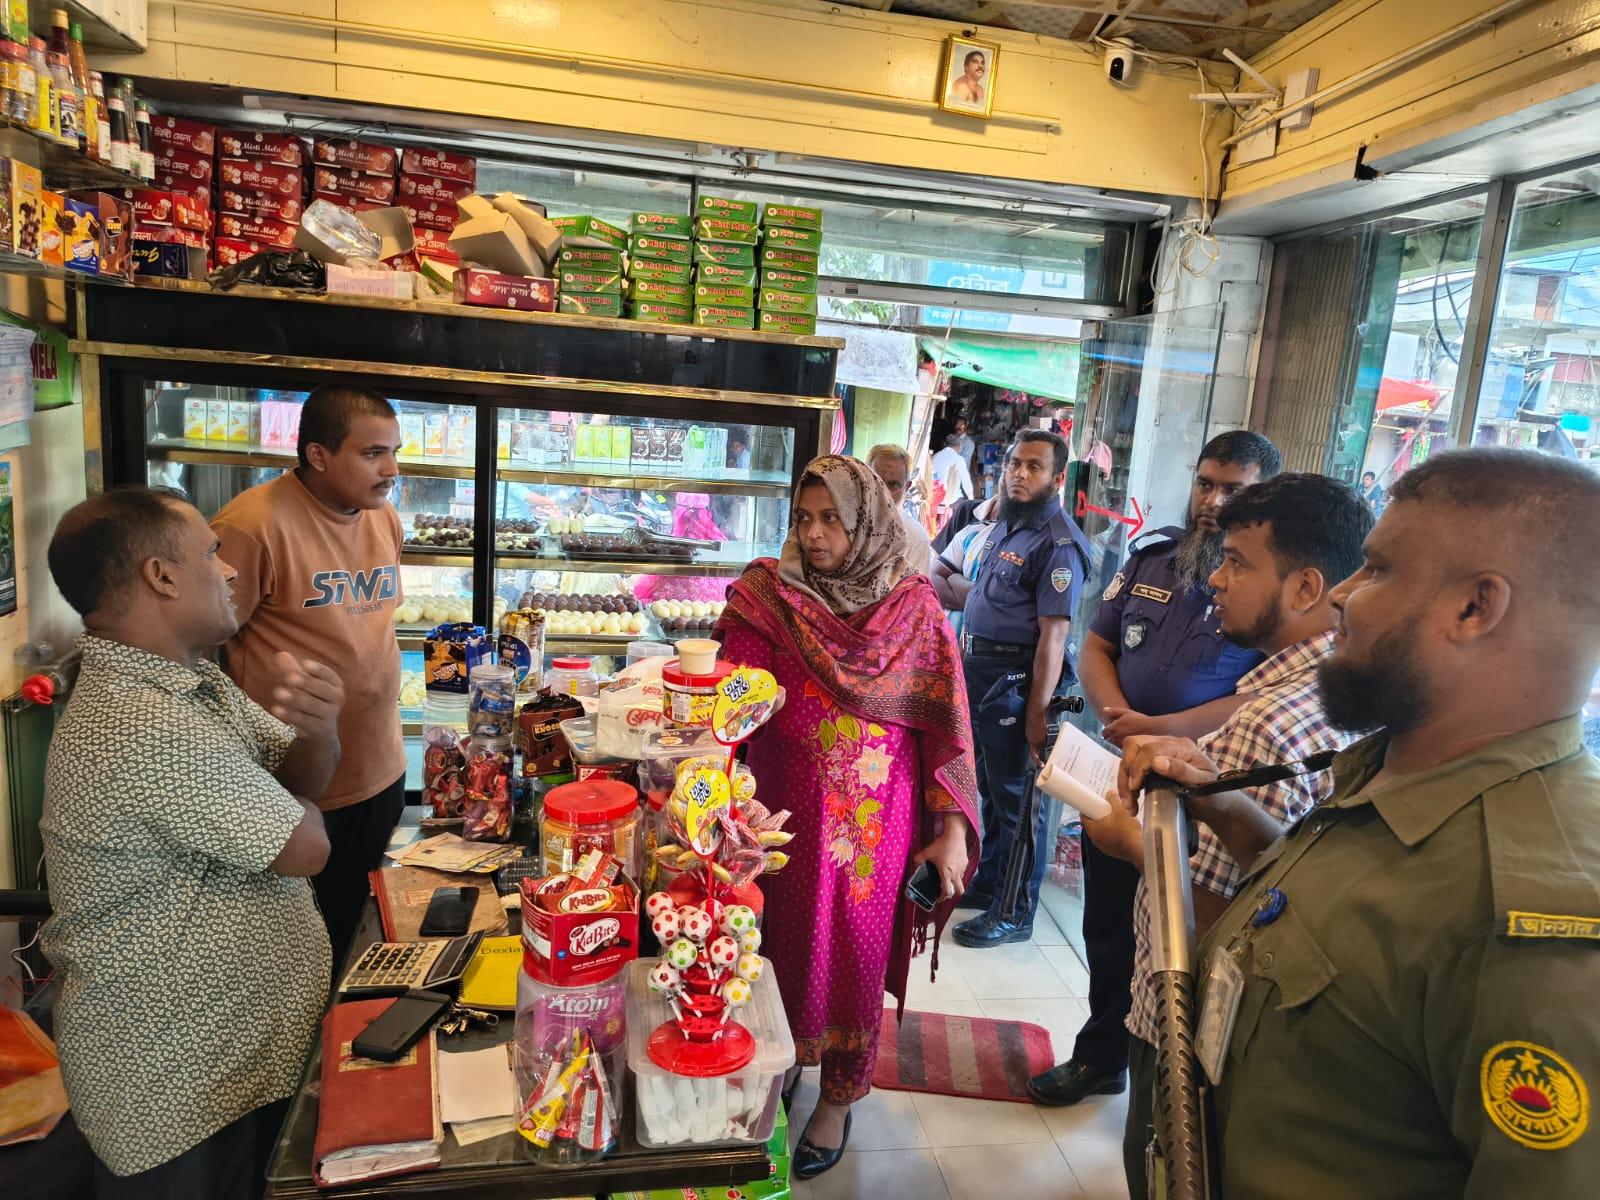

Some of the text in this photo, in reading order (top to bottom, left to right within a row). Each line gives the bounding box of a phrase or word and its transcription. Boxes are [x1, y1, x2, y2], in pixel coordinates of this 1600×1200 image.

[154, 127, 191, 142] মিষ্টি মেলা
[241, 142, 281, 153] Misti Mela
[422, 156, 457, 172] মিষ্টি মেলা
[418, 184, 453, 198] মিষ্টি মেলা
[418, 211, 434, 222] মিষ্টি
[241, 223, 280, 236] Misti Mela
[575, 921, 619, 953] KidBite
[547, 995, 610, 1013] Atom
[1500, 1102, 1566, 1134] আনসার
